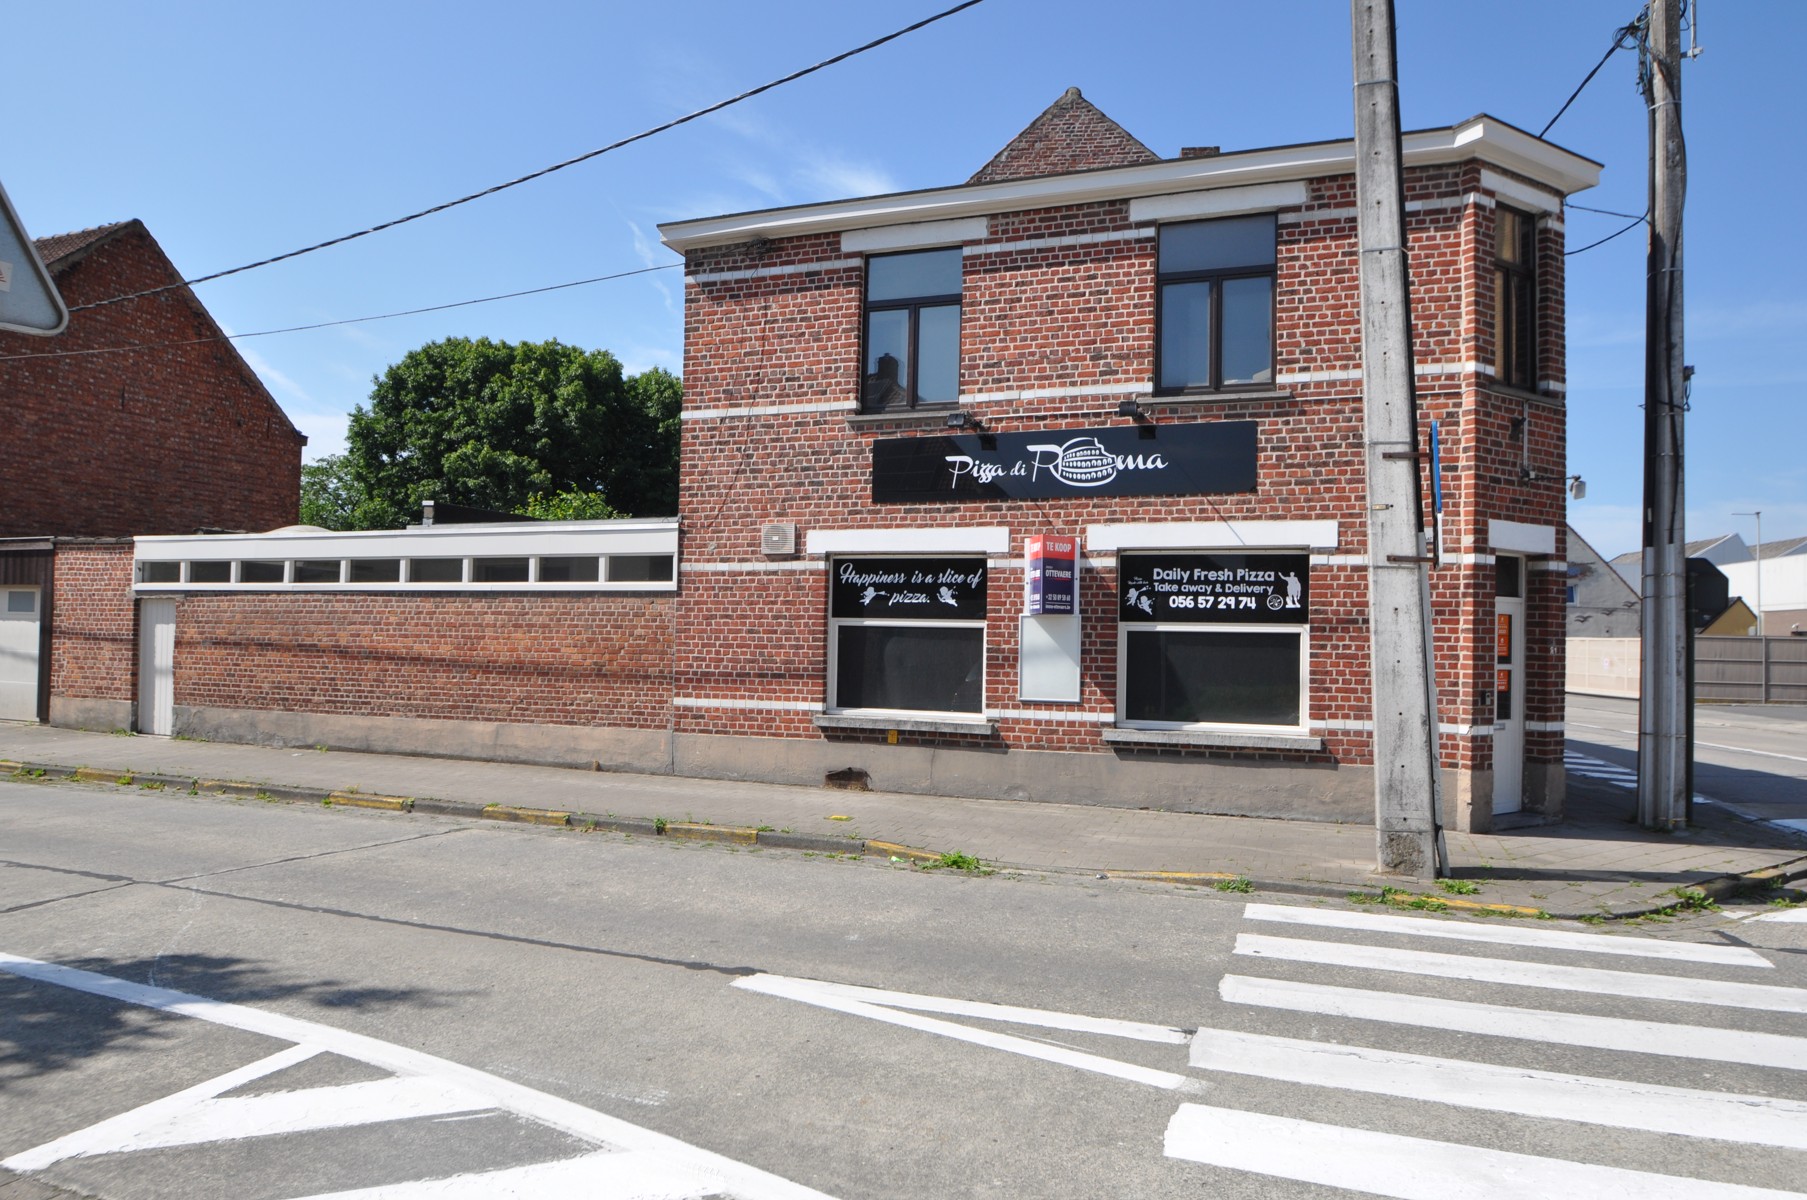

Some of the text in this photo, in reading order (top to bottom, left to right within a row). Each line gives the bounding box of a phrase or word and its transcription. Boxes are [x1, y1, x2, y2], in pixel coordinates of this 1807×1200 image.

[945, 456, 1007, 489] Pizza
[1010, 460, 1027, 477] di
[1046, 541, 1053, 551] TE
[1055, 542, 1072, 553] KOOP
[839, 562, 983, 589] Happiness is a slice of
[1153, 567, 1190, 583] Daily
[1193, 568, 1234, 581] Fresh
[1236, 569, 1275, 582] Pizza
[1153, 582, 1274, 595] Take away & Delivery
[888, 590, 931, 607] pizza.
[1169, 595, 1257, 610] 056 57 29 74
